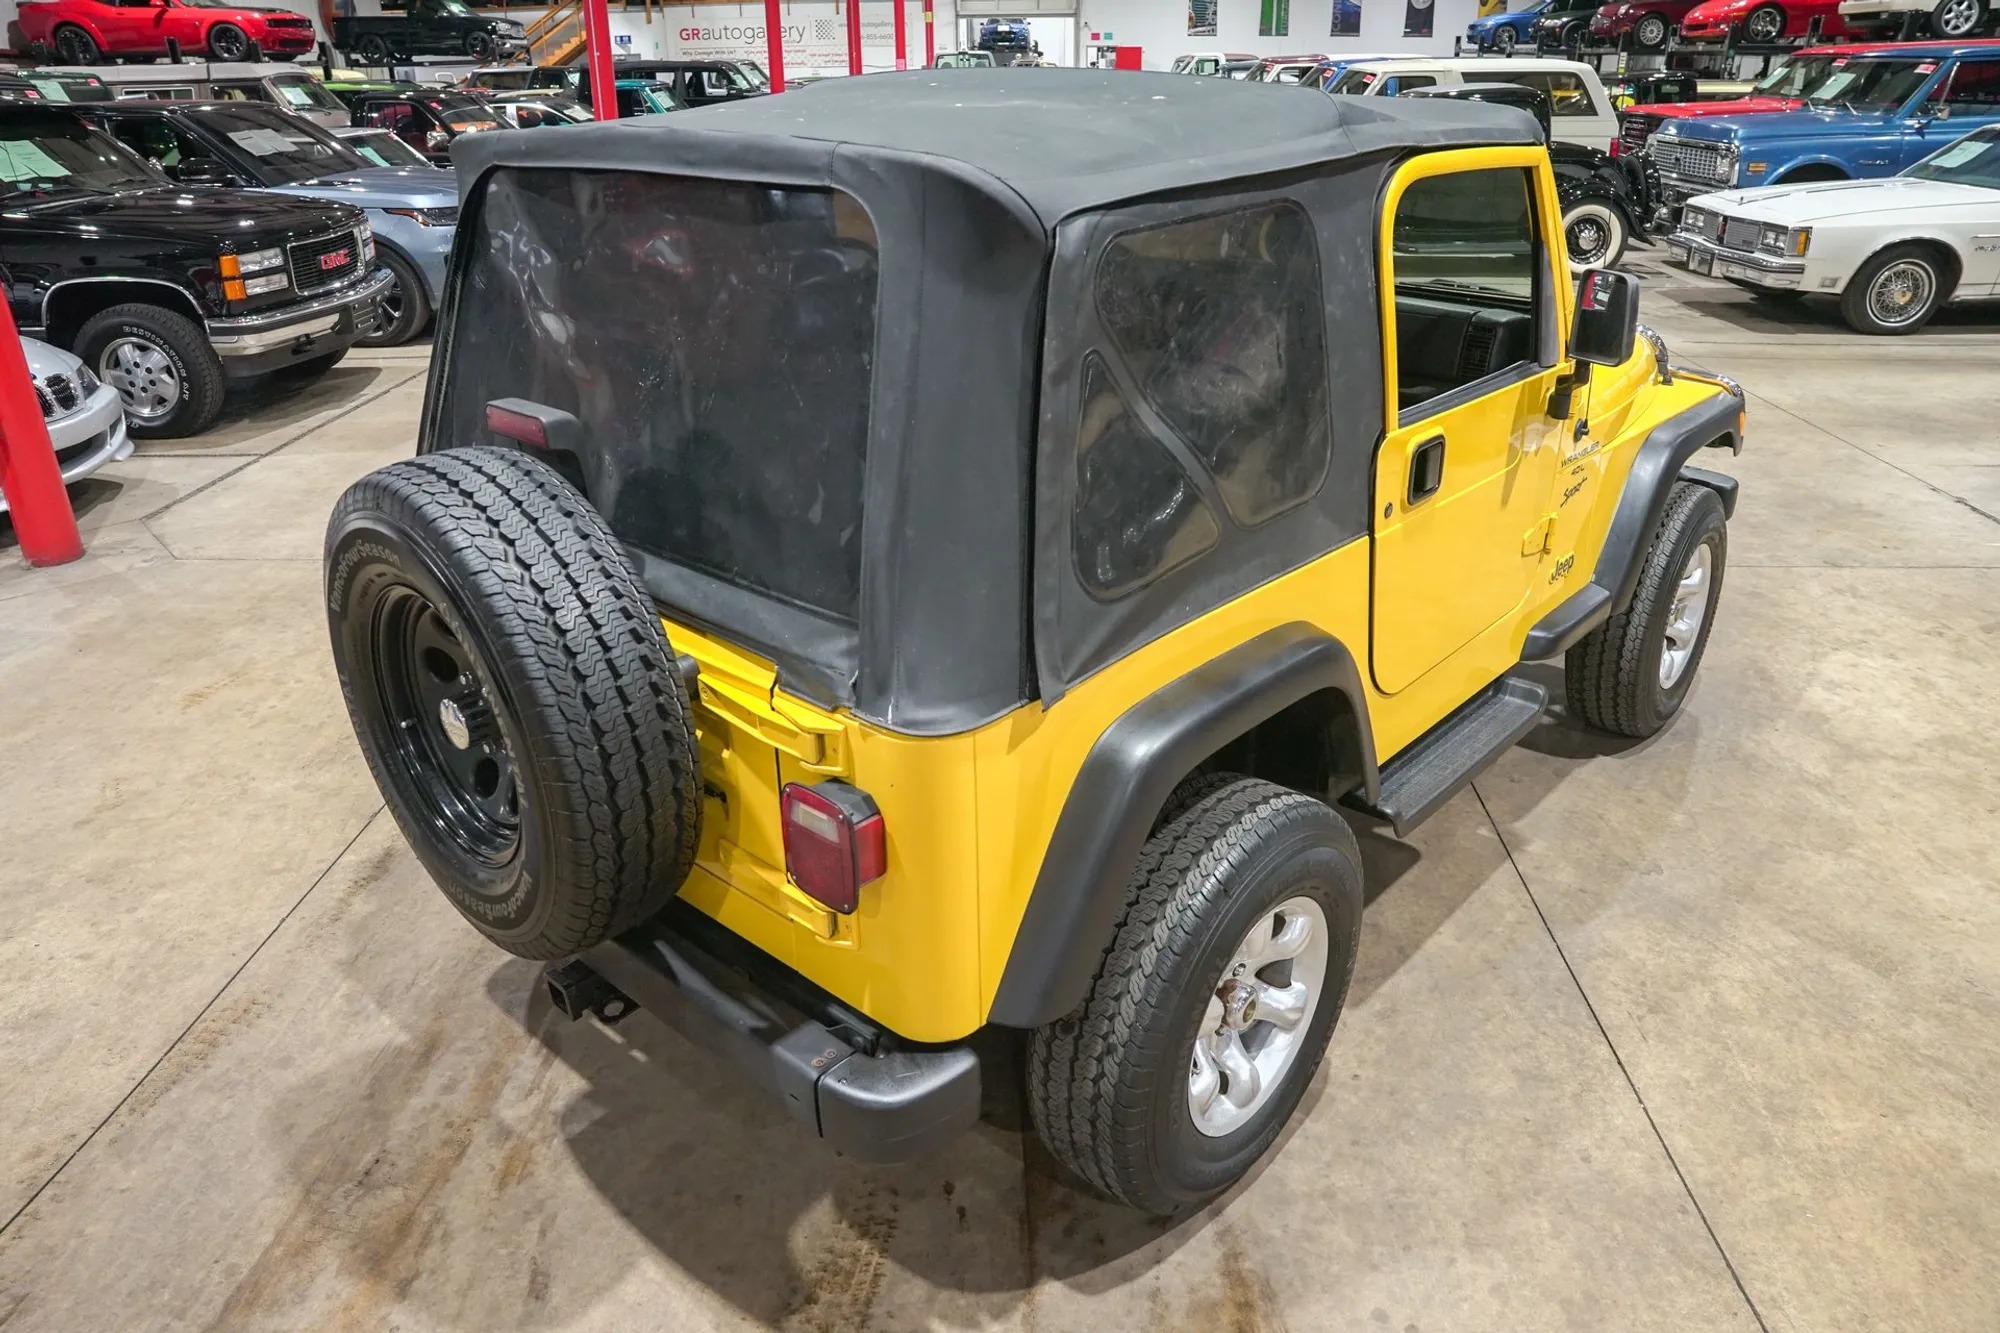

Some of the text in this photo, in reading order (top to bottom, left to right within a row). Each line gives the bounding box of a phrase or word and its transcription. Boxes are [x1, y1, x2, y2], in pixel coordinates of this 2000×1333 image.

[679, 24, 805, 44] GRautogaery
[320, 250, 351, 270] GMC
[122, 325, 187, 377] DESTINATION
[1561, 441, 1599, 468] WRANGLER
[1560, 476, 1588, 508] Sport
[330, 539, 401, 613] VancoFourSeason
[1550, 553, 1574, 582] Jeep
[449, 869, 533, 921] VancoFourSeason
